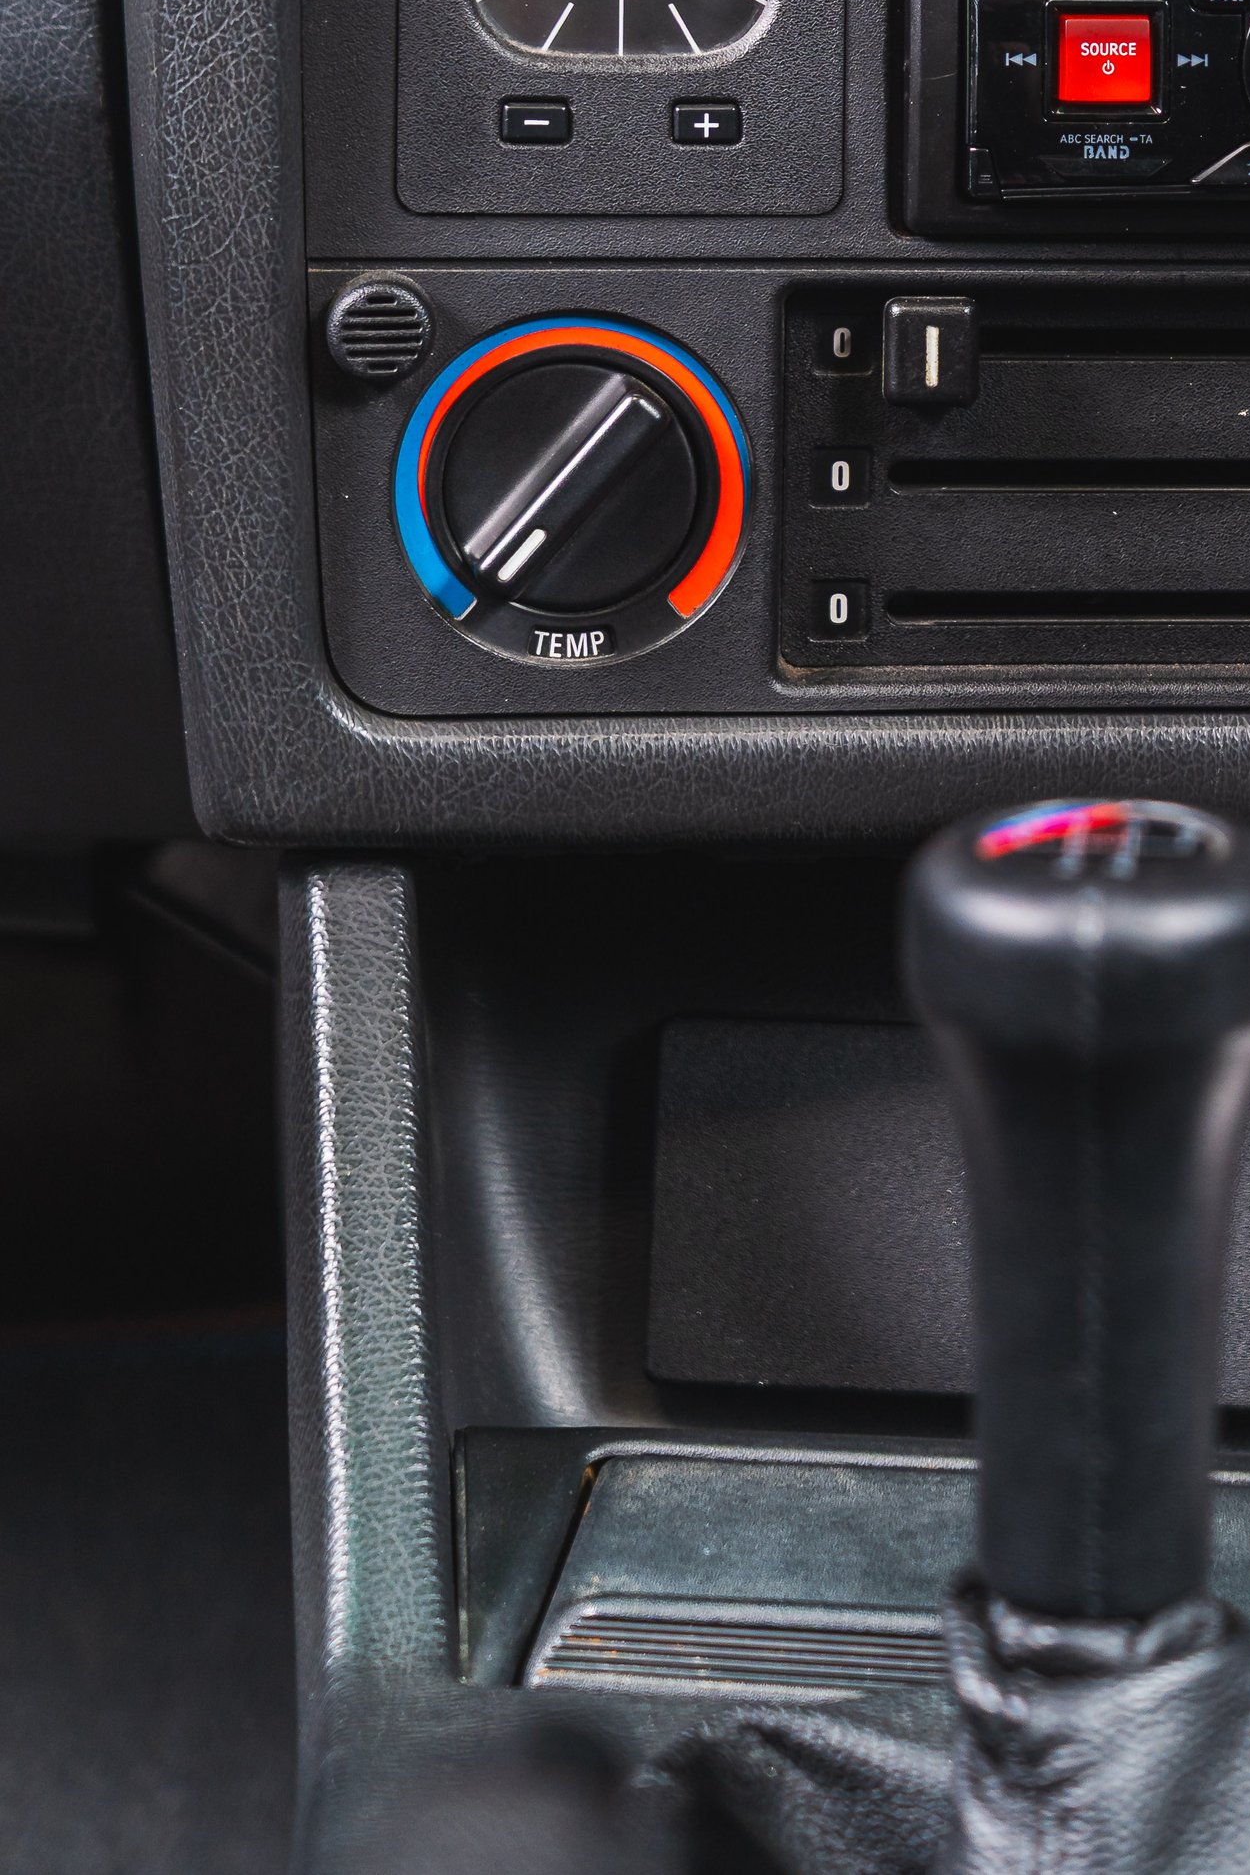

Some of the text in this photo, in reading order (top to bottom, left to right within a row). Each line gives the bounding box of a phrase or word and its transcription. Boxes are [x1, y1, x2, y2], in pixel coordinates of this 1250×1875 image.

[1080, 41, 1137, 57] SOURCE
[1060, 134, 1124, 144] ABC SEARCH
[1139, 134, 1153, 144] TA
[1083, 145, 1130, 159] BAND
[834, 327, 851, 357] 0
[831, 460, 850, 491] 0
[829, 594, 848, 624] 0
[533, 629, 606, 660] TEMP
